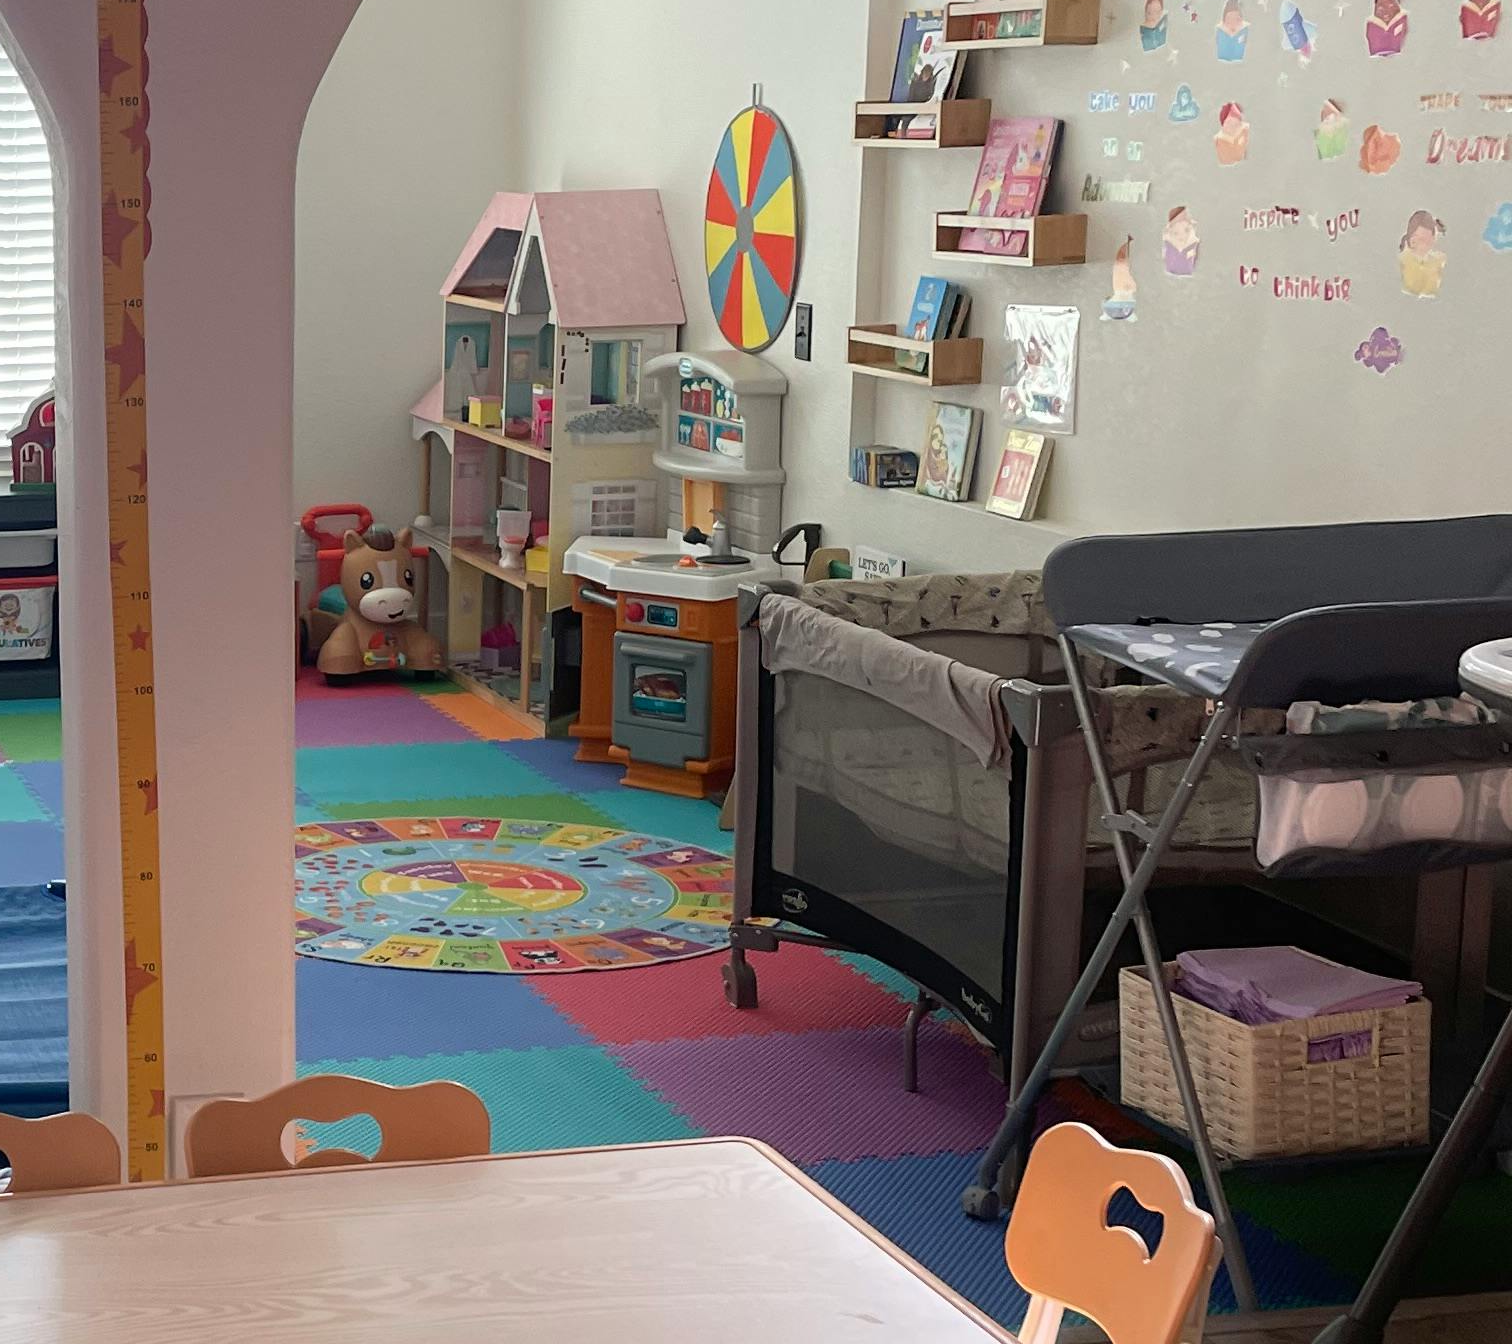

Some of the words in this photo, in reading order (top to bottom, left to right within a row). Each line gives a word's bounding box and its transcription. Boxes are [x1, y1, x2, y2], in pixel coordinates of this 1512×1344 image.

[120, 95, 139, 107] 160
[122, 197, 141, 209] 150
[123, 297, 143, 309] 140
[125, 396, 144, 408] 130
[127, 494, 146, 506] 120
[130, 590, 149, 601] 110
[134, 685, 153, 696] 100
[137, 778, 151, 789] 90
[140, 871, 153, 881] 80
[143, 962, 155, 972] 70
[144, 1053, 157, 1063] 60
[146, 1142, 158, 1152] 50
